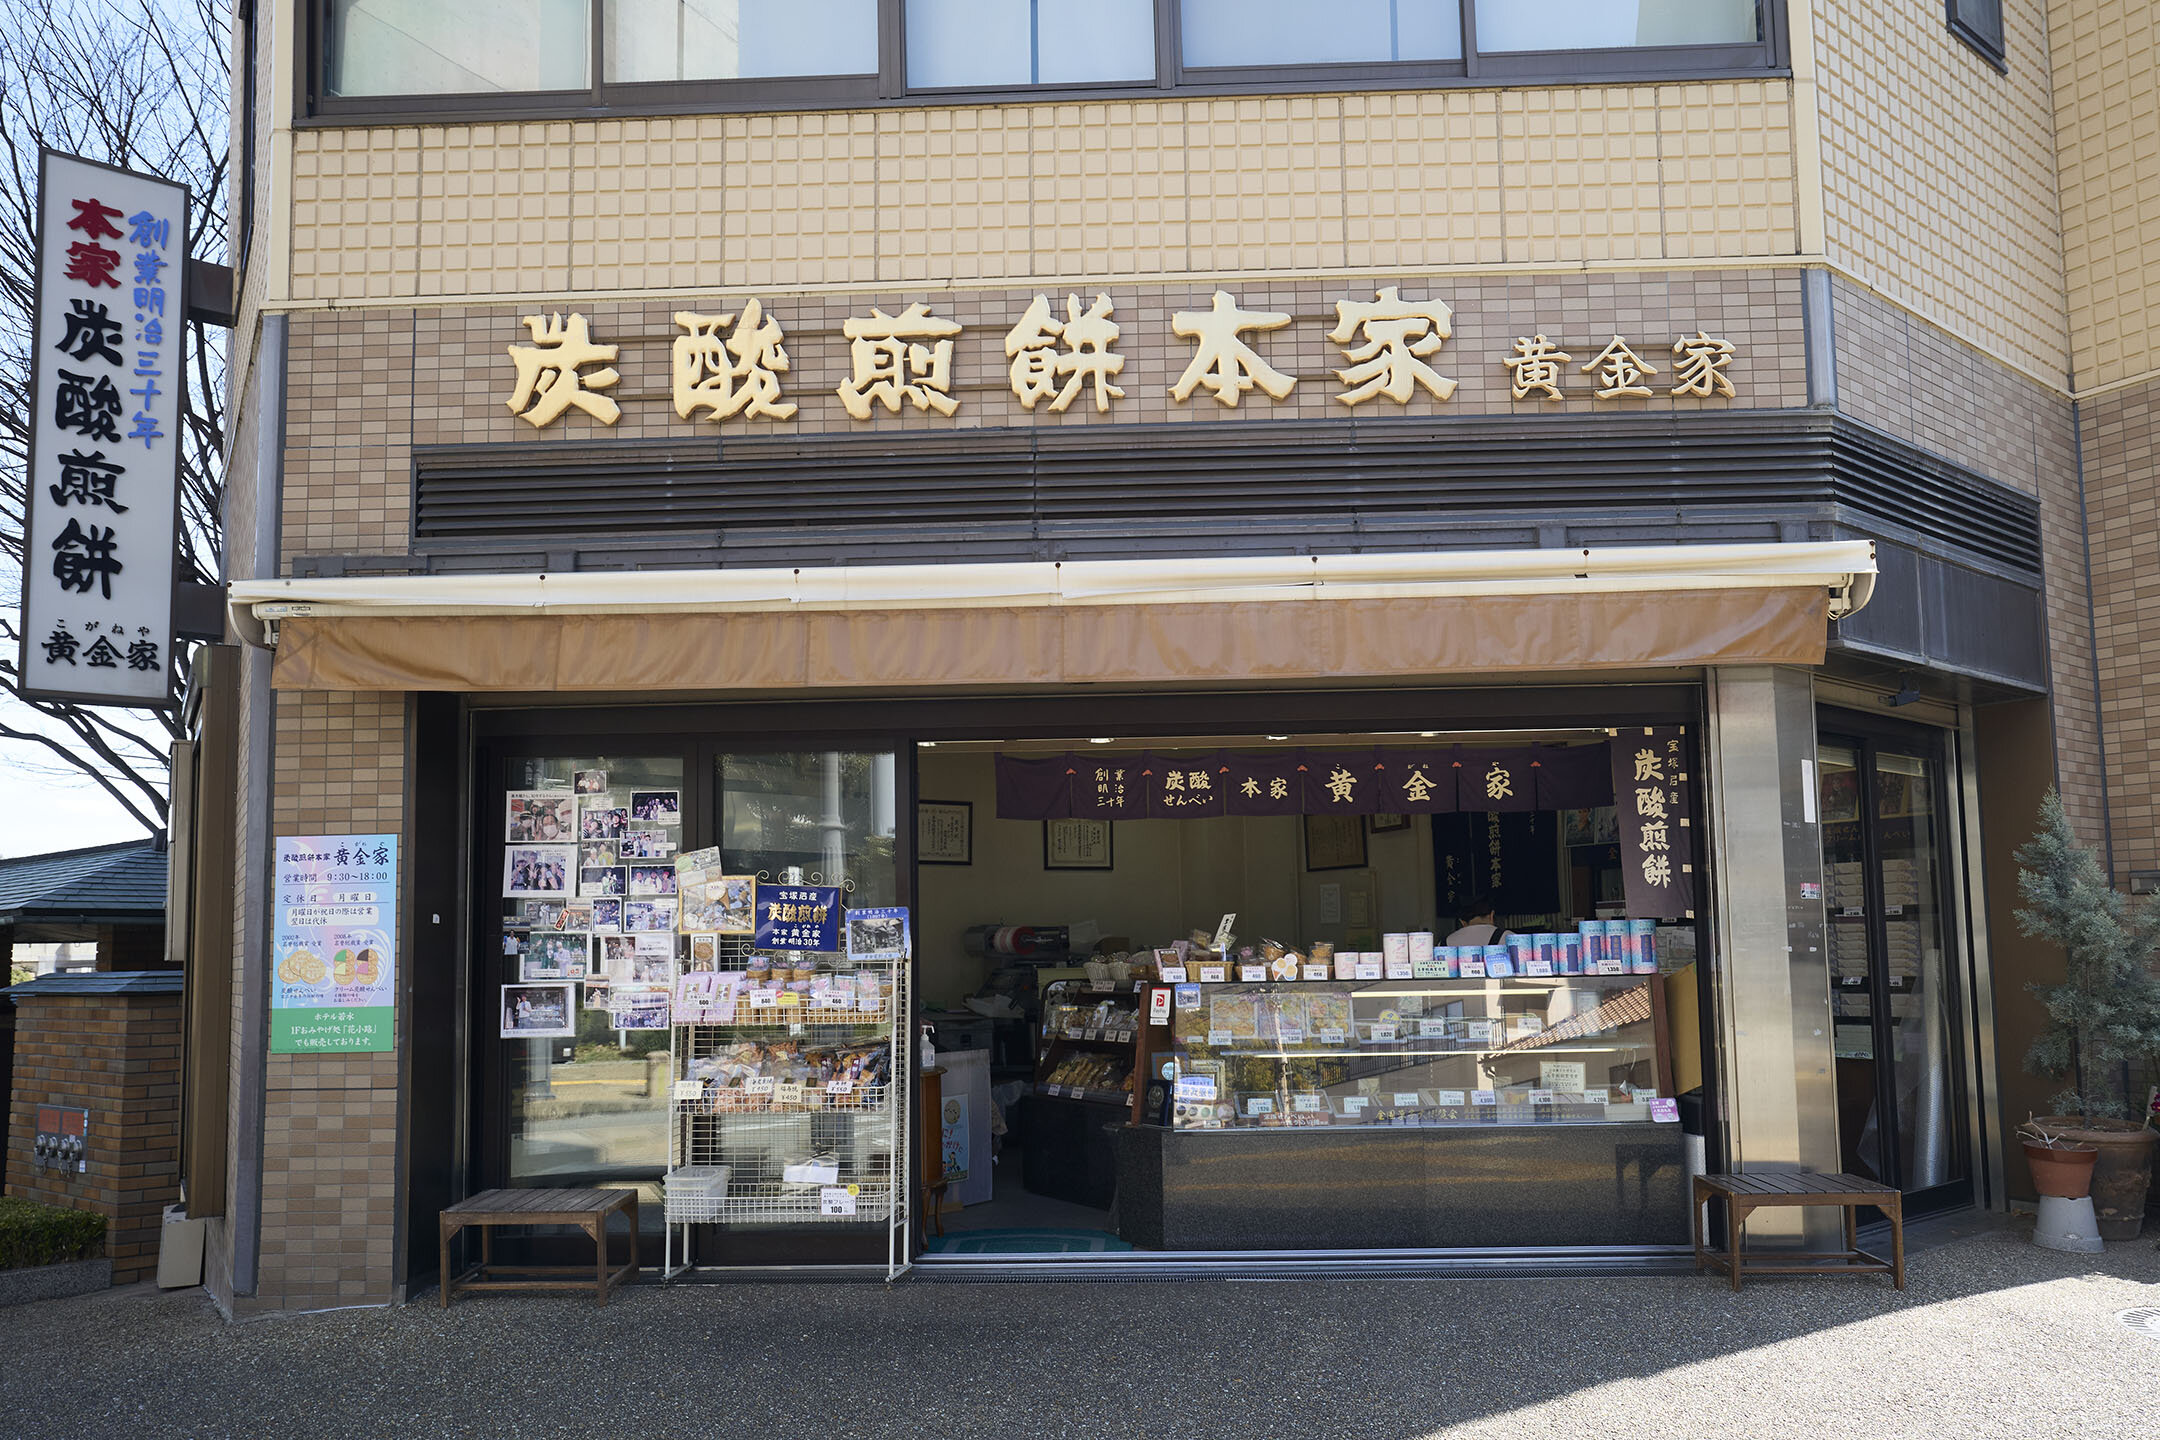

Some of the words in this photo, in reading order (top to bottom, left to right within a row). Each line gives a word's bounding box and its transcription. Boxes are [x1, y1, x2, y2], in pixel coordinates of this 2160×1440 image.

[63, 198, 125, 289] 本家
[128, 210, 170, 450] 創業明治三十年
[507, 288, 1460, 428] 炭酸煎餅本家
[1501, 330, 1738, 402] 黄金家
[49, 299, 129, 600] 炭酸煎餅
[56, 618, 151, 637] こがねや
[40, 629, 161, 673] 黄金家
[1094, 767, 1126, 782] 創業
[1164, 769, 1212, 793] 炭酸
[1666, 739, 1681, 805] 宝塚名産
[1096, 783, 1125, 795] 明治
[1239, 776, 1289, 800] 本家
[1324, 766, 1514, 804] 黄金家
[1096, 795, 1126, 808] 三十年
[1162, 794, 1214, 807] せんべい
[1633, 748, 1673, 889] 炭酸煎餅
[333, 846, 390, 866] 黄金家
[283, 873, 318, 883] 営業時間
[282, 894, 317, 904] 定休日
[338, 893, 372, 902] 月曜日
[767, 902, 828, 924] 炭酸煎餅
